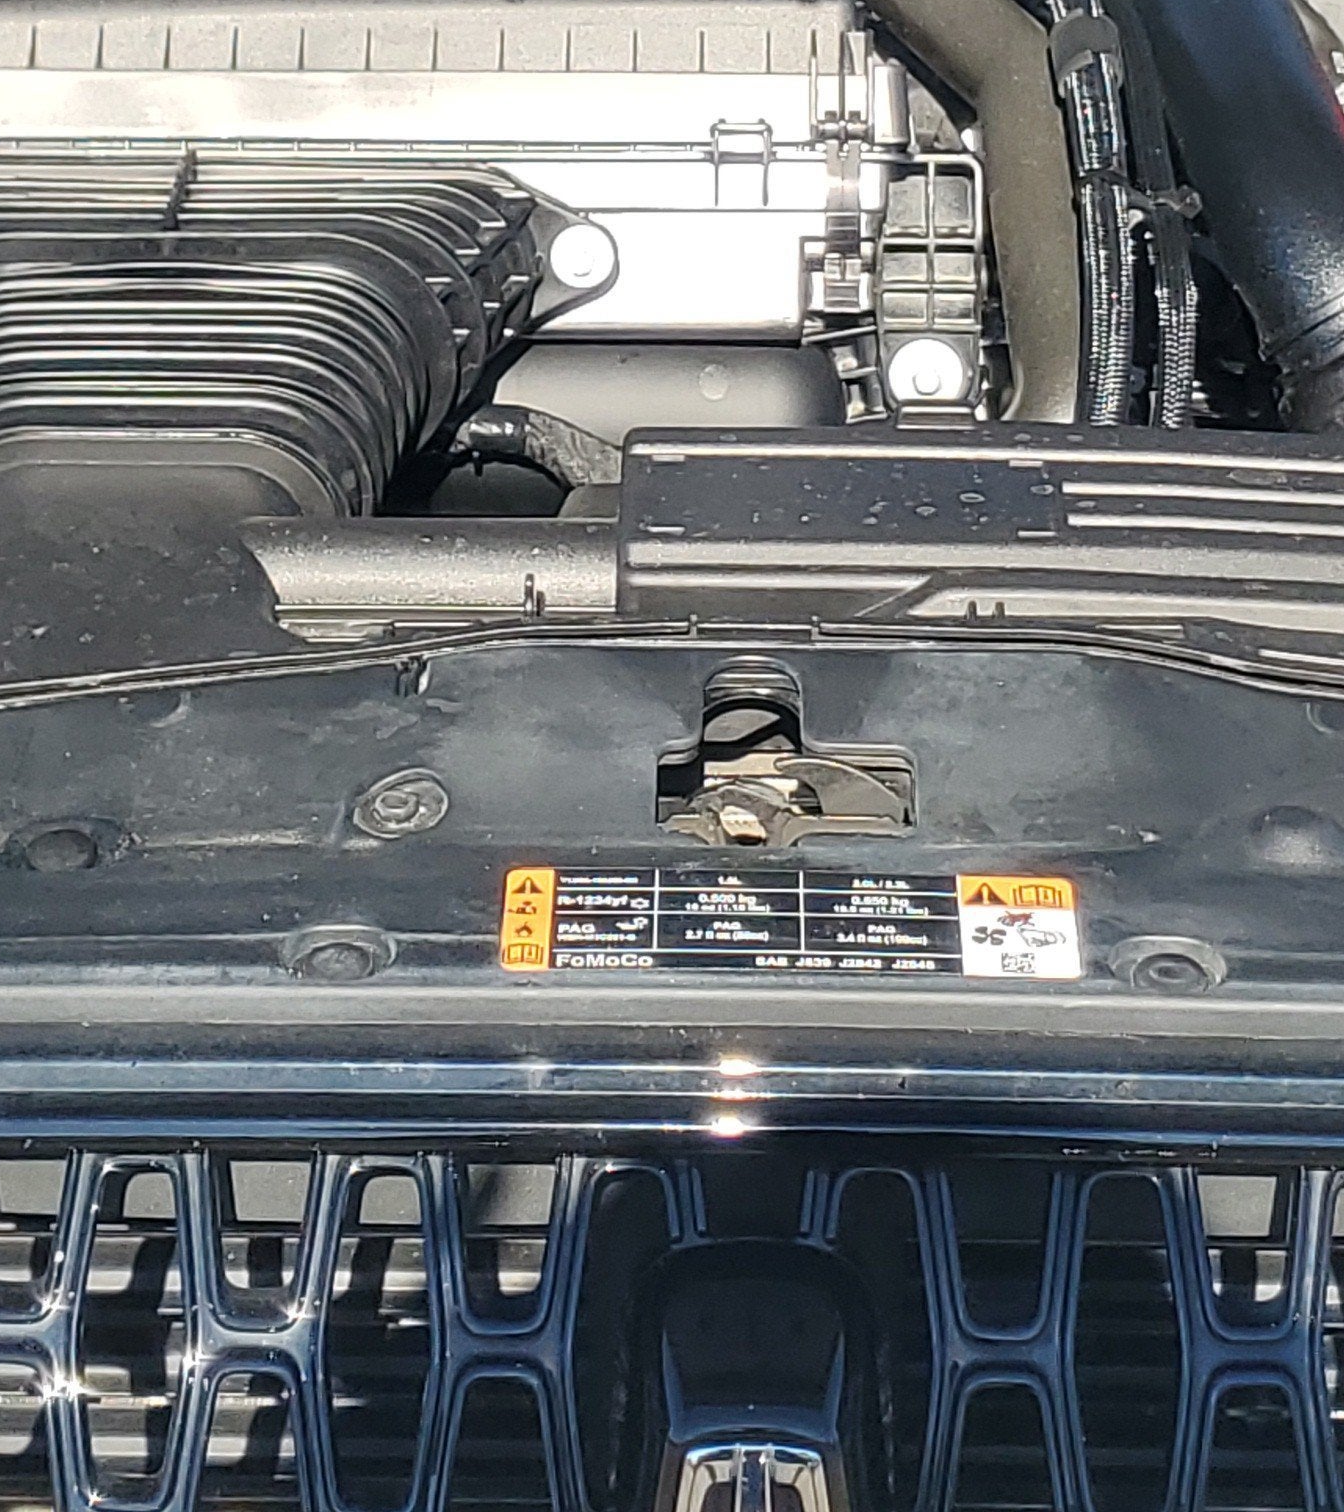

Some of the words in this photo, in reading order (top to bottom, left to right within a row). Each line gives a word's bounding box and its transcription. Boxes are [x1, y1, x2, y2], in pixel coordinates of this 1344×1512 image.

[557, 894, 628, 907] R-1234yf
[558, 923, 596, 933] PAG
[713, 921, 742, 930] PAG
[867, 924, 896, 933] PAG
[556, 954, 653, 967] FoMoCo
[756, 956, 788, 966] SAE
